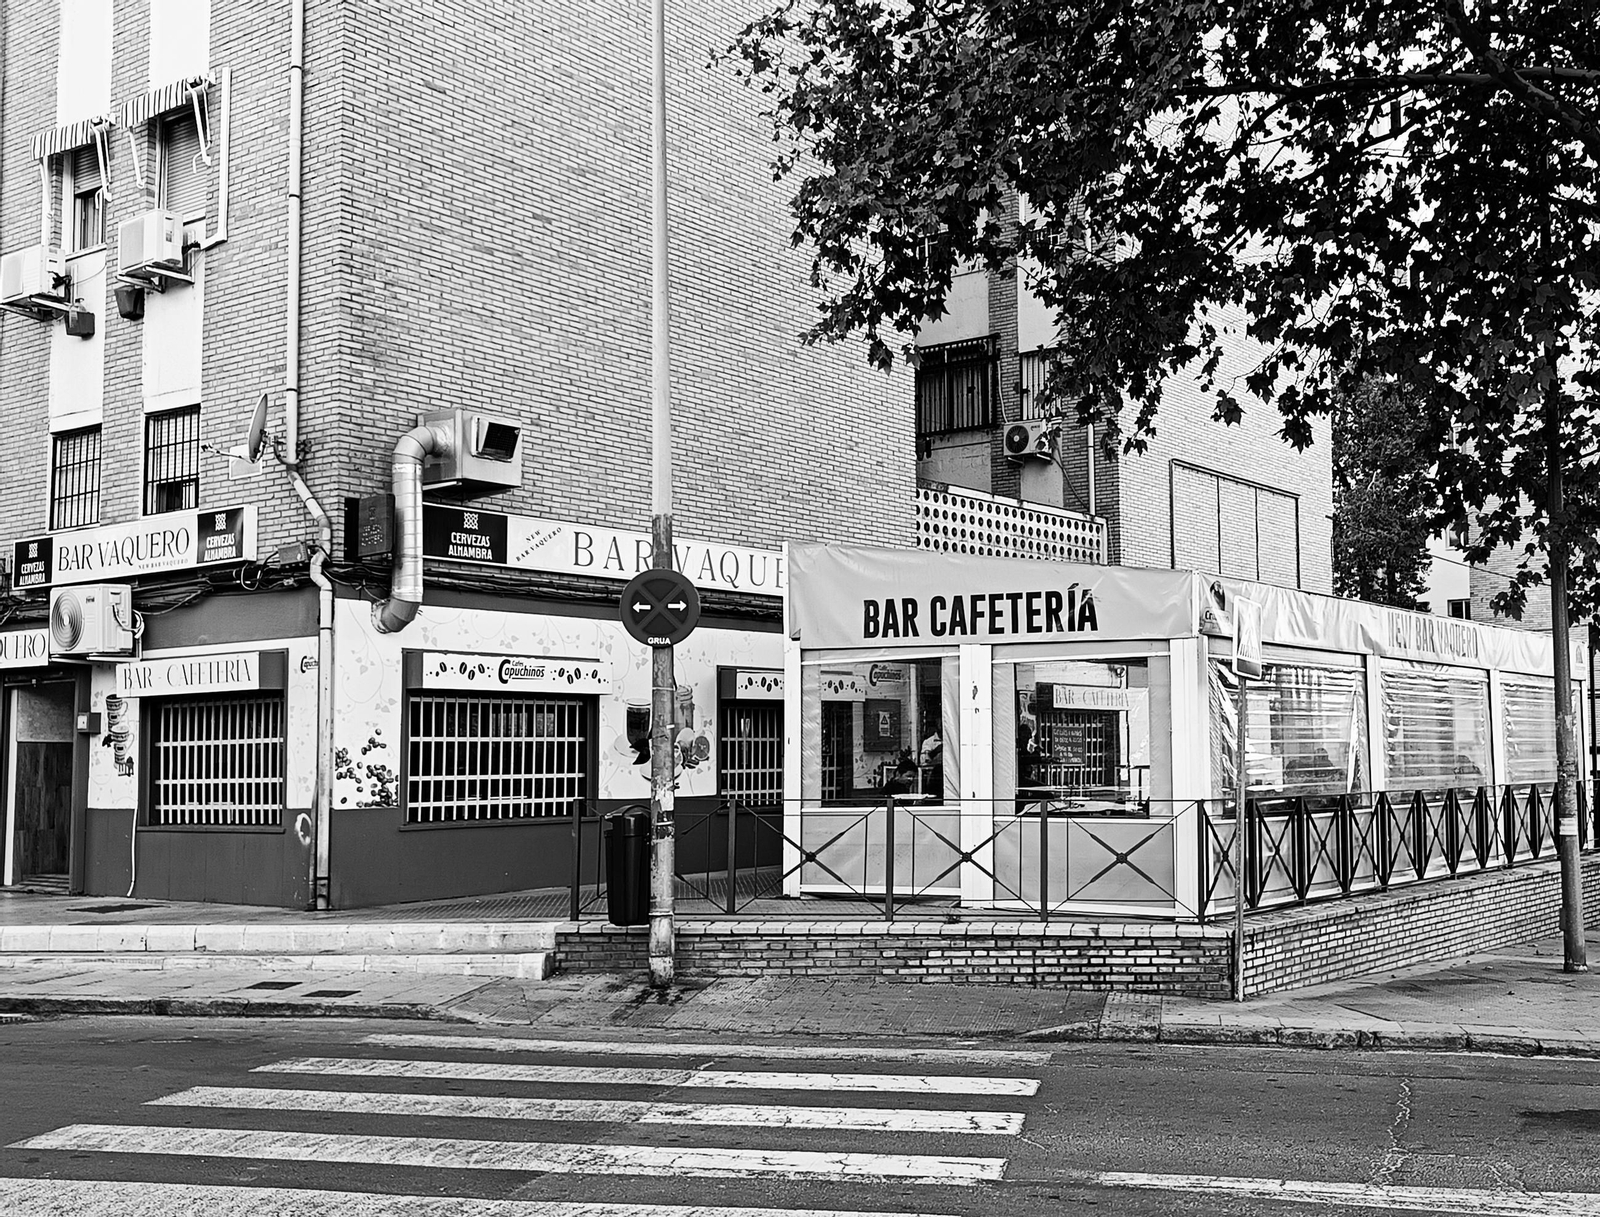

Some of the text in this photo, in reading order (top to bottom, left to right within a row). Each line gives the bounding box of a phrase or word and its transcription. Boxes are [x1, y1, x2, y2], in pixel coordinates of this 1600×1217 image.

[206, 533, 235, 549] CERVEZAS
[451, 532, 490, 547] CERVEZAS
[525, 529, 541, 543] NEW
[58, 527, 190, 571] BAR VAQUERO
[448, 545, 493, 560] ALHAMBRA
[515, 527, 562, 562] BAR VAQUERO
[573, 531, 653, 573] BAR
[204, 546, 237, 561] ALHAMBRA
[21, 561, 45, 574] CERVEZAS
[19, 573, 46, 585] ALHAMBRA
[863, 582, 1098, 639] BAR CAFETERÍA
[647, 637, 671, 645] GRUA
[1415, 616, 1436, 653] BAR
[1437, 620, 1478, 661] VAQUERO
[123, 666, 152, 690] BAR
[498, 659, 545, 684] Capuchinos
